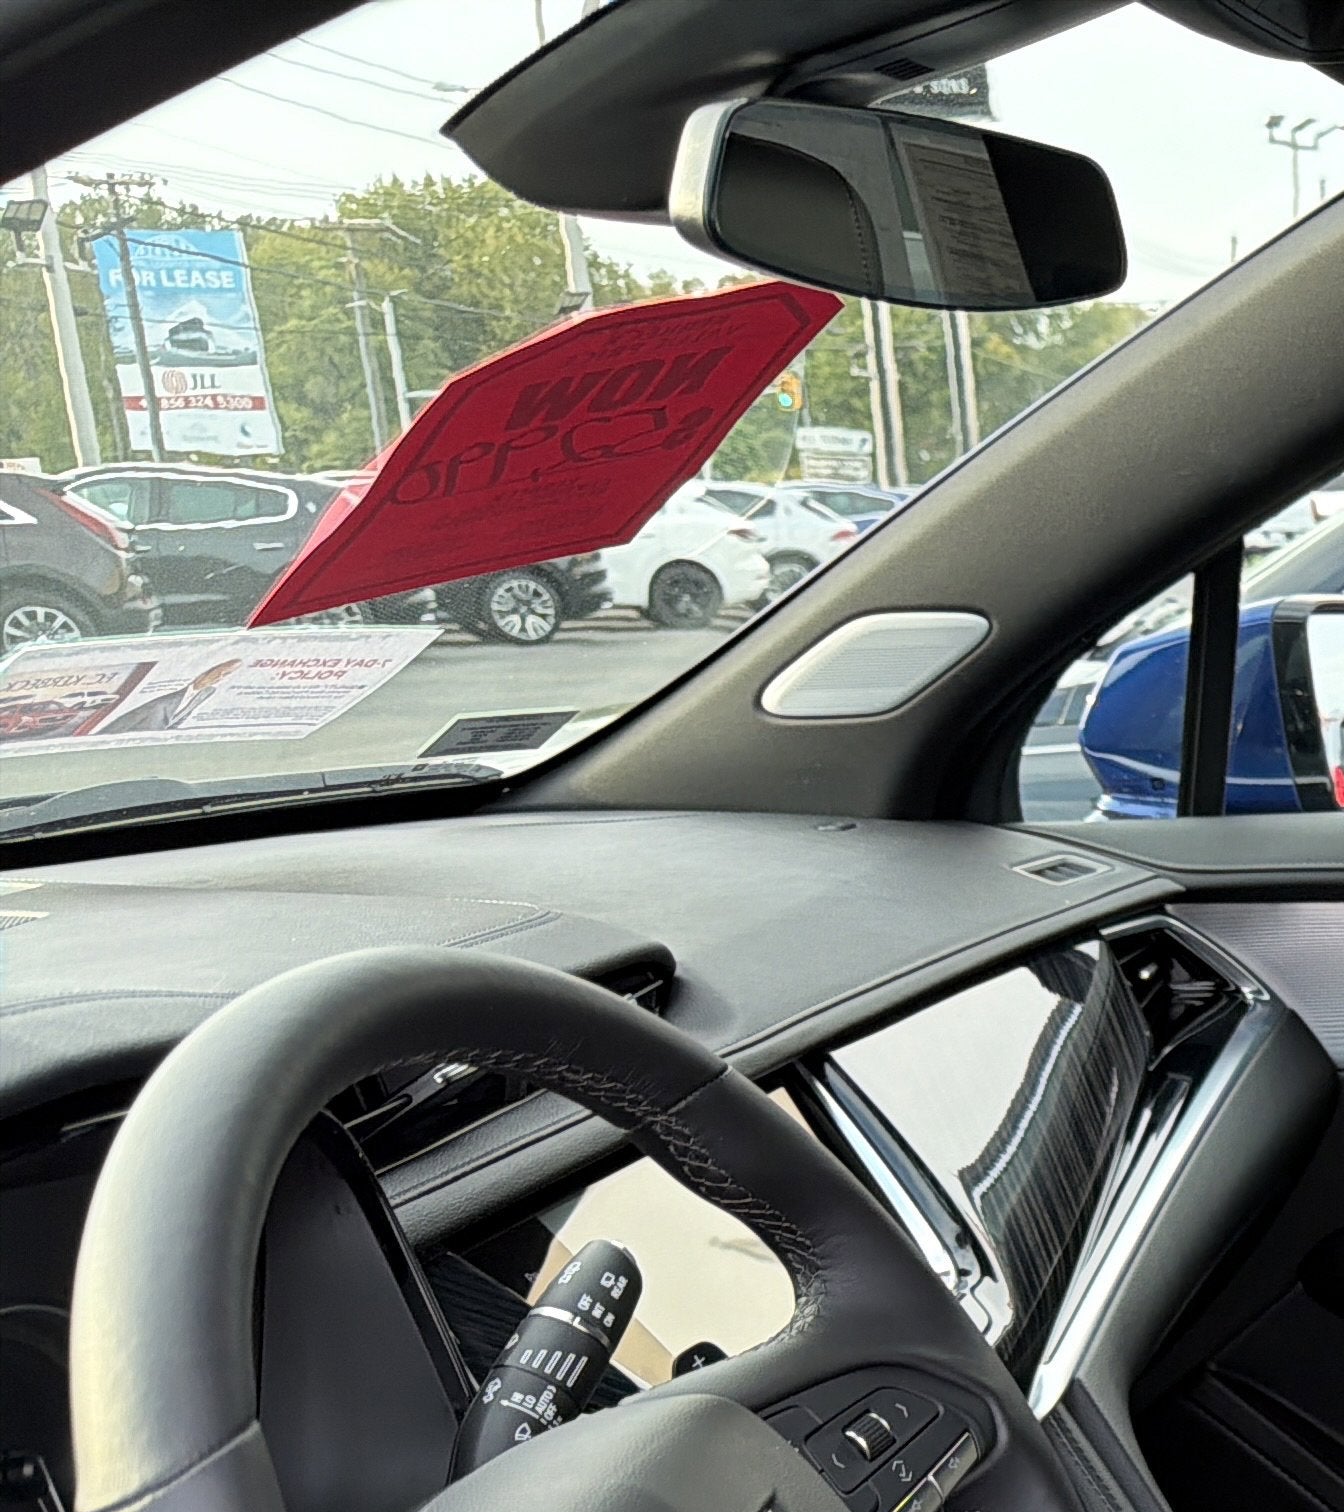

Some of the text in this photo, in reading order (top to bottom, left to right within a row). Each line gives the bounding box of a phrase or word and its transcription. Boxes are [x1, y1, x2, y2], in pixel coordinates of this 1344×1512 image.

[160, 269, 235, 288] LEASE
[190, 373, 221, 391] JLL
[611, 1275, 628, 1300] REAR
[578, 1293, 593, 1311] OFF
[592, 1302, 605, 1319] INT
[603, 1312, 616, 1328] ON
[510, 1391, 524, 1404] HI
[522, 1394, 537, 1409] LO
[534, 1389, 553, 1416] AUTO
[543, 1403, 558, 1421] OFF
